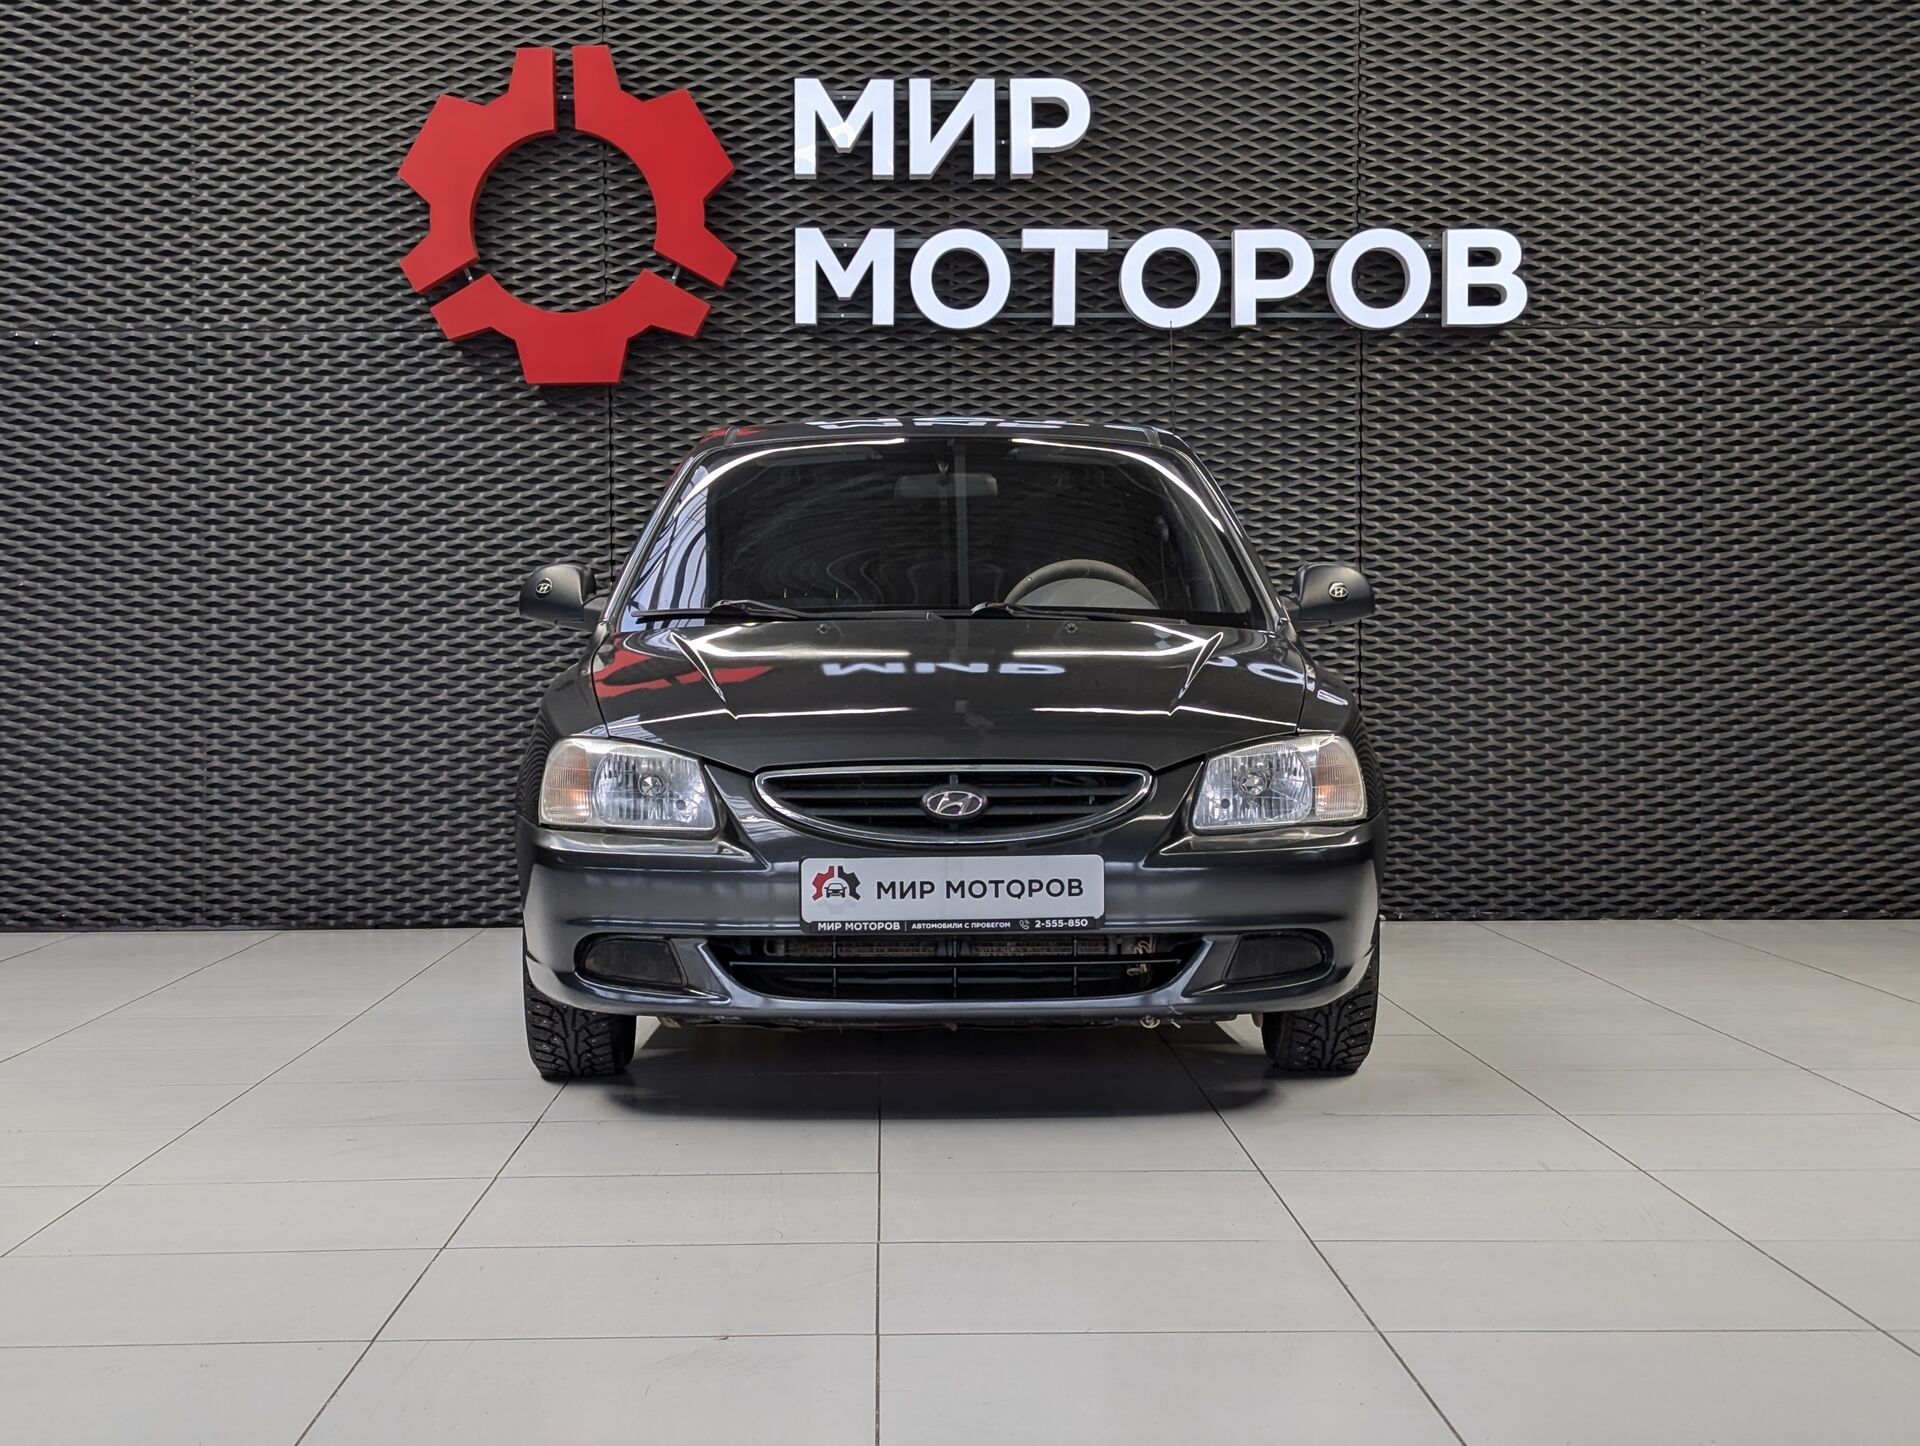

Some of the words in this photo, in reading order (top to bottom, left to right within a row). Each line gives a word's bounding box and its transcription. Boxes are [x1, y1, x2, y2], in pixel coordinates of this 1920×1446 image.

[794, 77, 1091, 180] МИР
[794, 227, 1528, 329] МОТОРОВ
[876, 881, 935, 900] МИР
[945, 878, 1084, 899] МОТОРОВ
[817, 922, 842, 931] МИР
[845, 921, 901, 931] МОТОРОВ
[911, 921, 963, 930] АВТОМОБИЛИ
[971, 921, 1011, 929] ПРОБЕГОМ
[1035, 918, 1088, 928] 2-555-850
